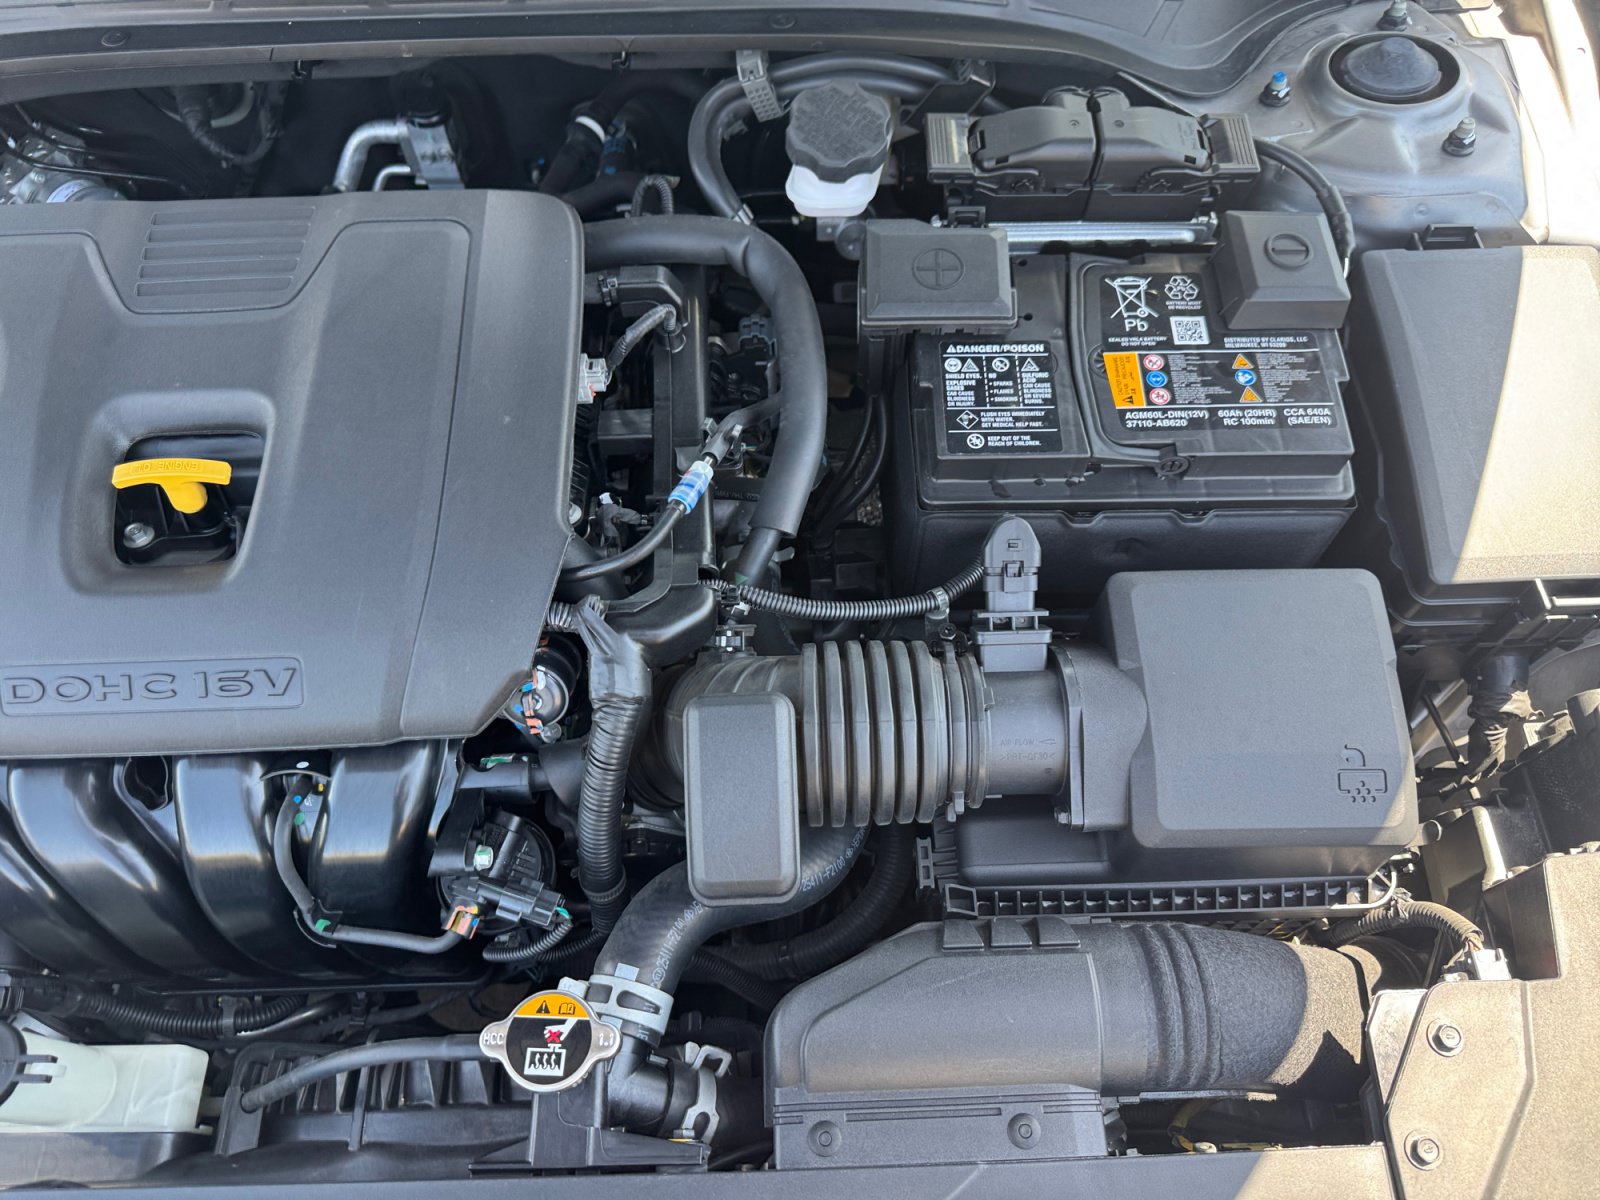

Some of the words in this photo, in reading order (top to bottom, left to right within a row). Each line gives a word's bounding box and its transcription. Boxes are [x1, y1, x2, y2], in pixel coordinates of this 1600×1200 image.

[1124, 319, 1148, 332] Pb
[956, 344, 1044, 353] DANGER/POISON
[1125, 410, 1209, 419] AGM60L-DIN(12V)
[1244, 409, 1277, 418] (20HR)
[1284, 408, 1305, 416] CCA
[1126, 419, 1188, 428] 37110-AB620
[1288, 417, 1332, 426] (SAE/EN)
[160, 462, 199, 471] ENGINE
[3, 672, 178, 704] DOHC
[193, 668, 296, 698] 16V
[482, 1032, 505, 1046] HCC
[598, 1032, 614, 1046] 1.1
